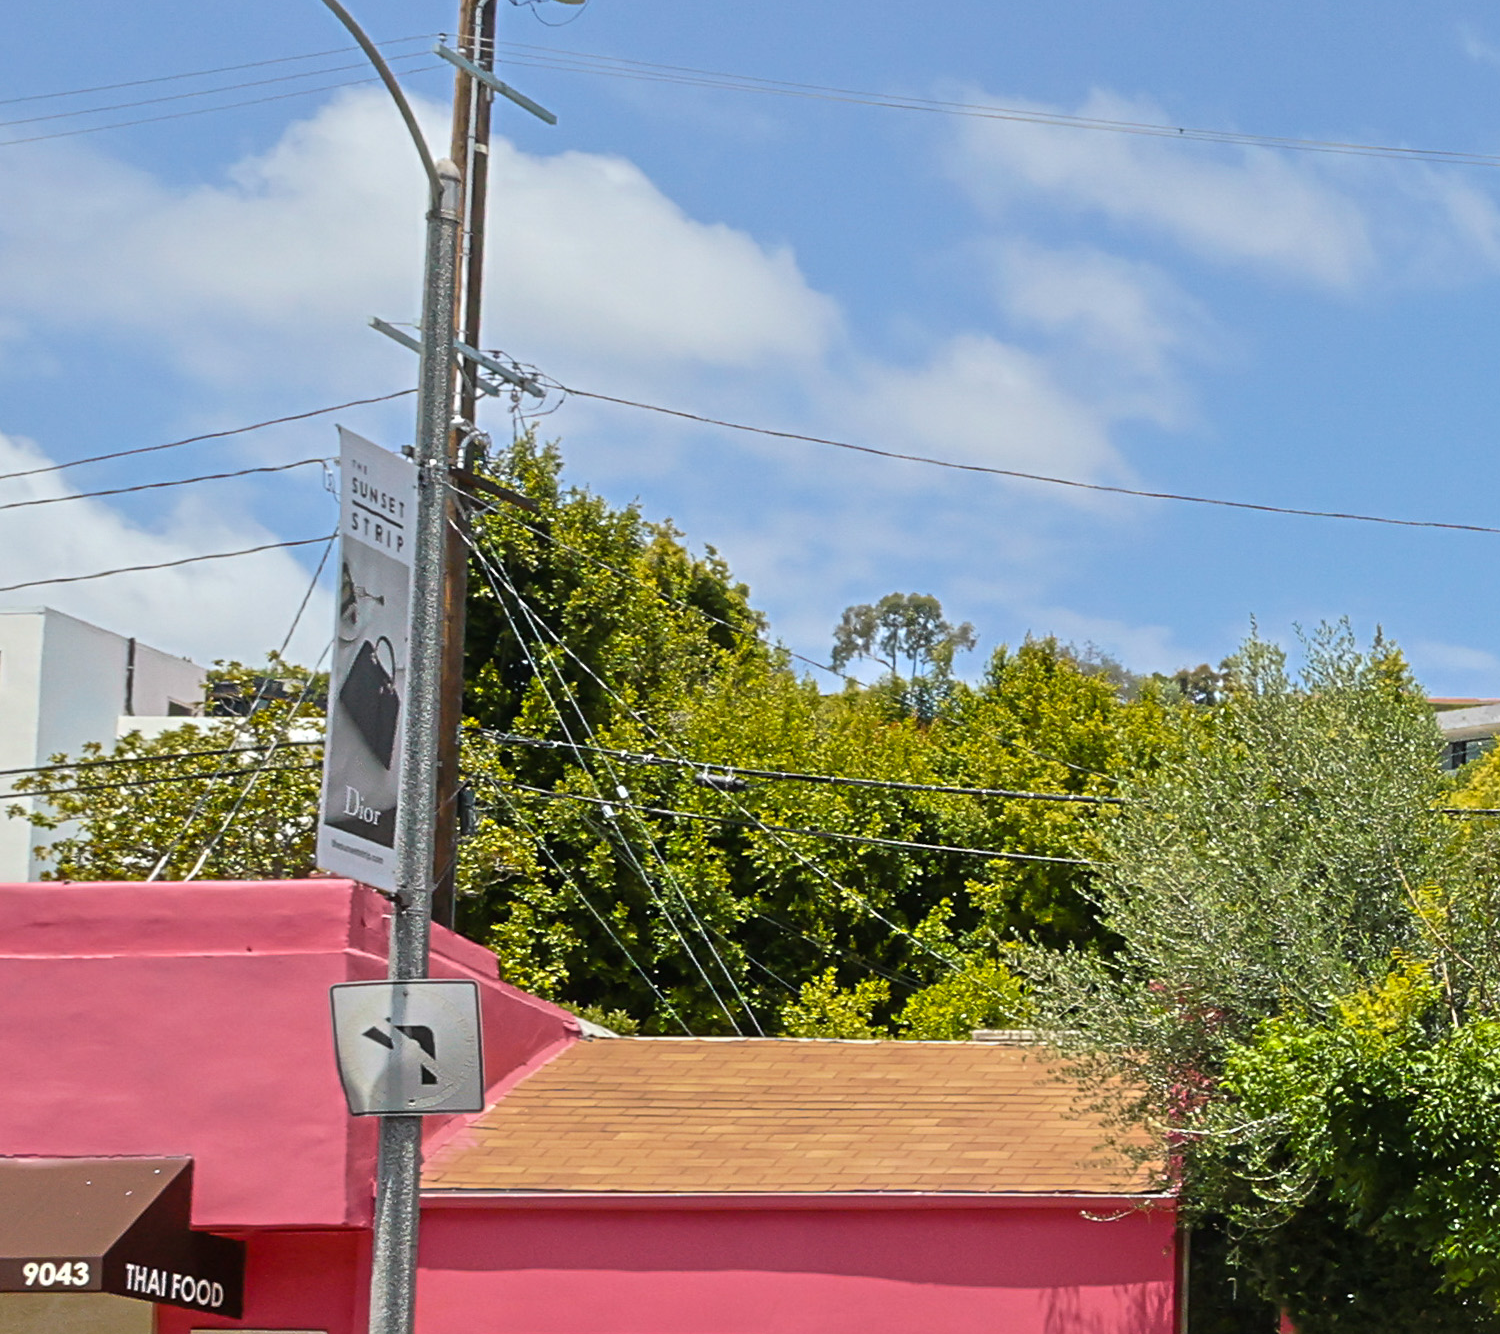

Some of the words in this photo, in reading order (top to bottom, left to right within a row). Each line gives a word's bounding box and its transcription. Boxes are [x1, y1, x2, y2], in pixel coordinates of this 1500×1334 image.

[351, 460, 368, 475] THE
[351, 477, 405, 518] SUNSET
[351, 512, 405, 553] STRIP
[343, 785, 382, 826] Dior
[23, 1262, 90, 1287] 9043
[125, 1263, 168, 1297] THAI
[171, 1272, 225, 1308] FOOD
